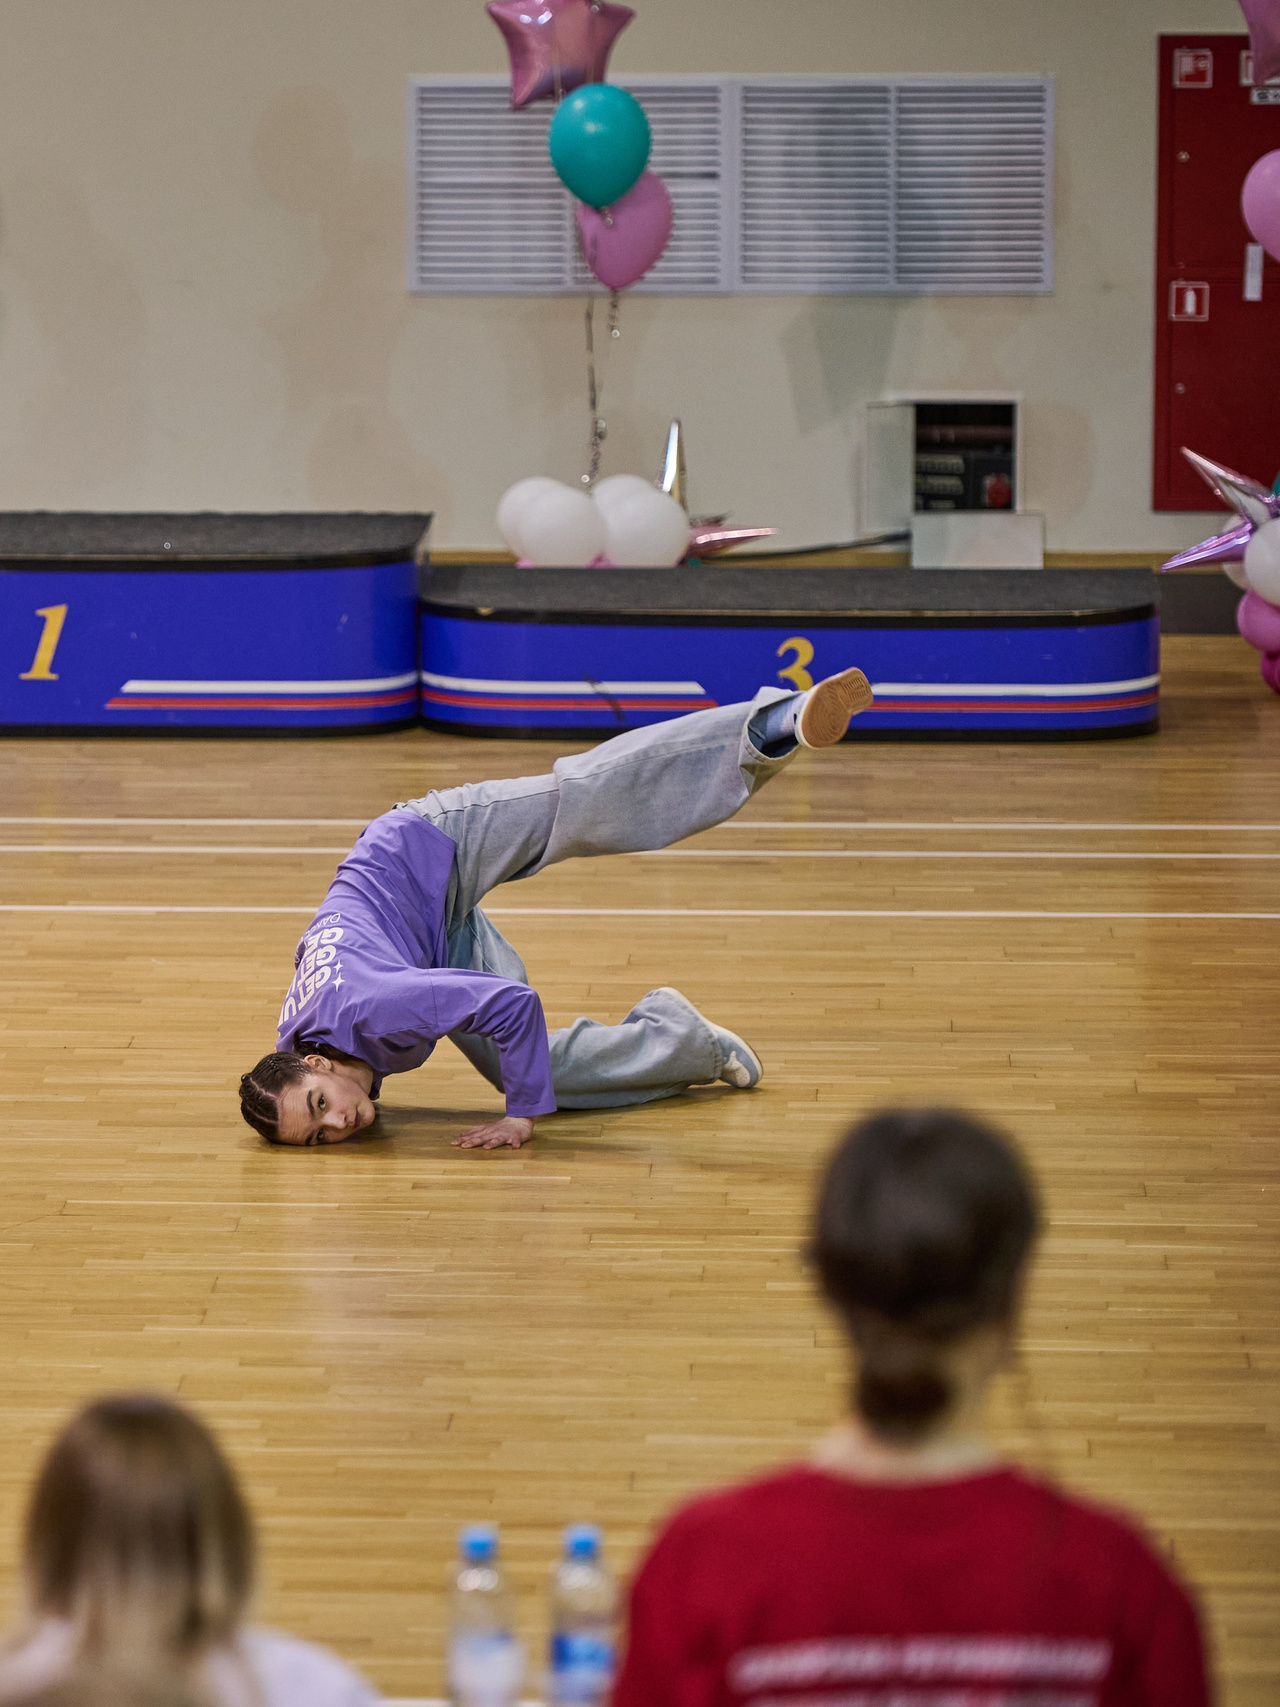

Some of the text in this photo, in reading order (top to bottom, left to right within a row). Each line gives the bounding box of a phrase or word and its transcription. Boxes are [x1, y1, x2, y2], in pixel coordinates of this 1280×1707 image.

[18, 603, 69, 681] 1
[776, 636, 815, 692] 3
[300, 926, 344, 964] GE
